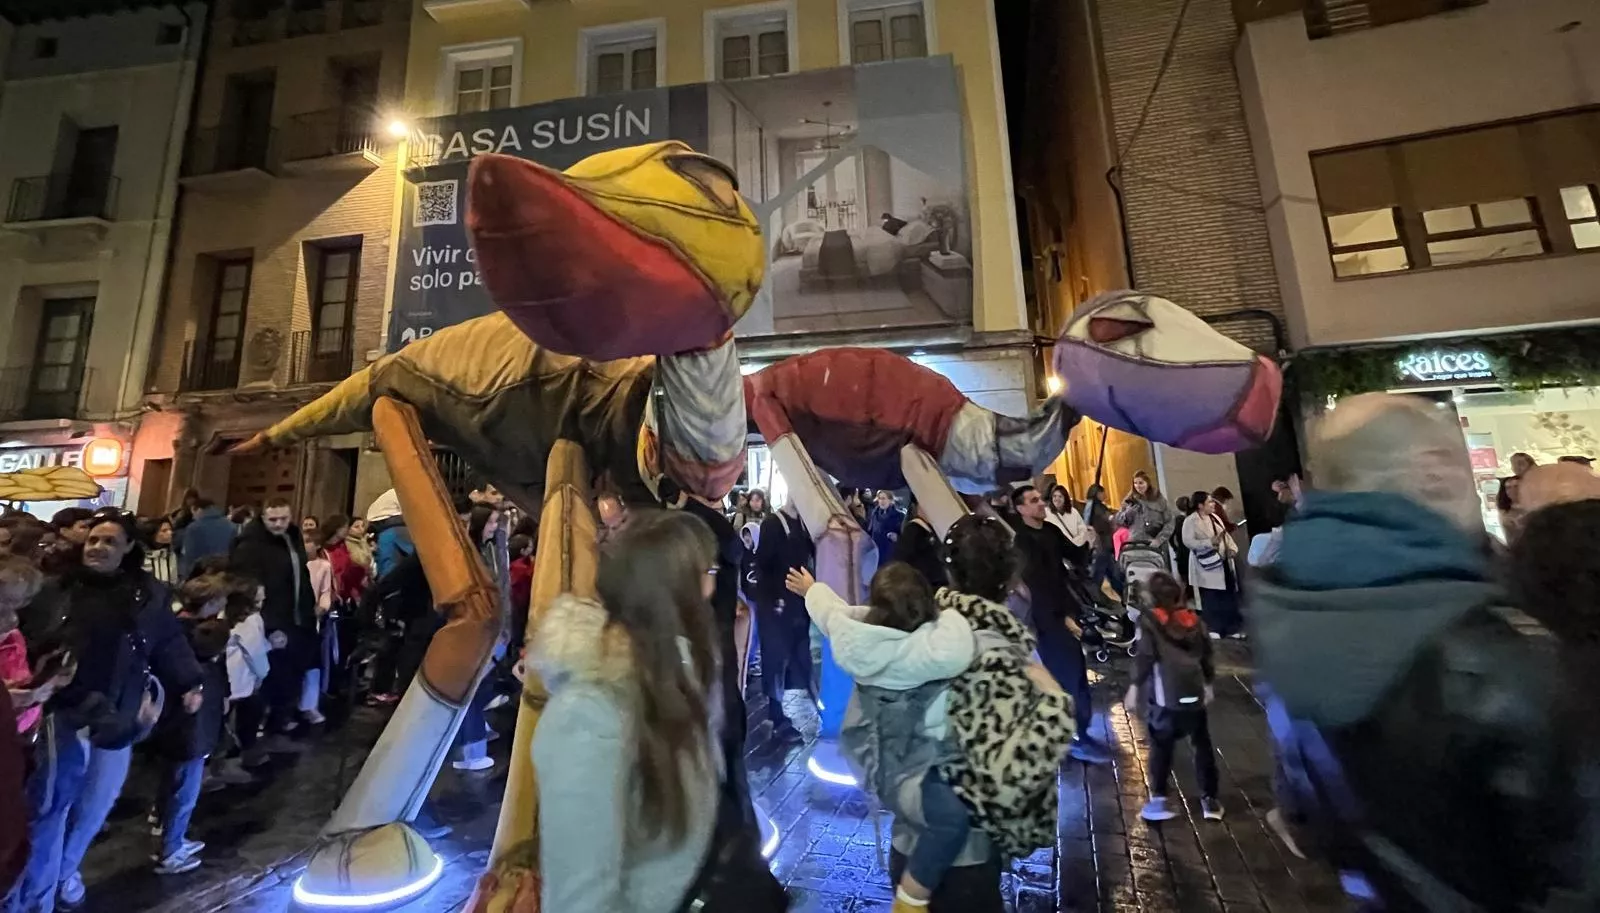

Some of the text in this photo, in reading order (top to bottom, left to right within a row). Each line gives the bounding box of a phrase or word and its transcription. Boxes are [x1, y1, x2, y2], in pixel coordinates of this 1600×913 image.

[532, 104, 650, 149] SUSÍN
[412, 244, 461, 267] Vivir
[410, 268, 453, 291] solo
